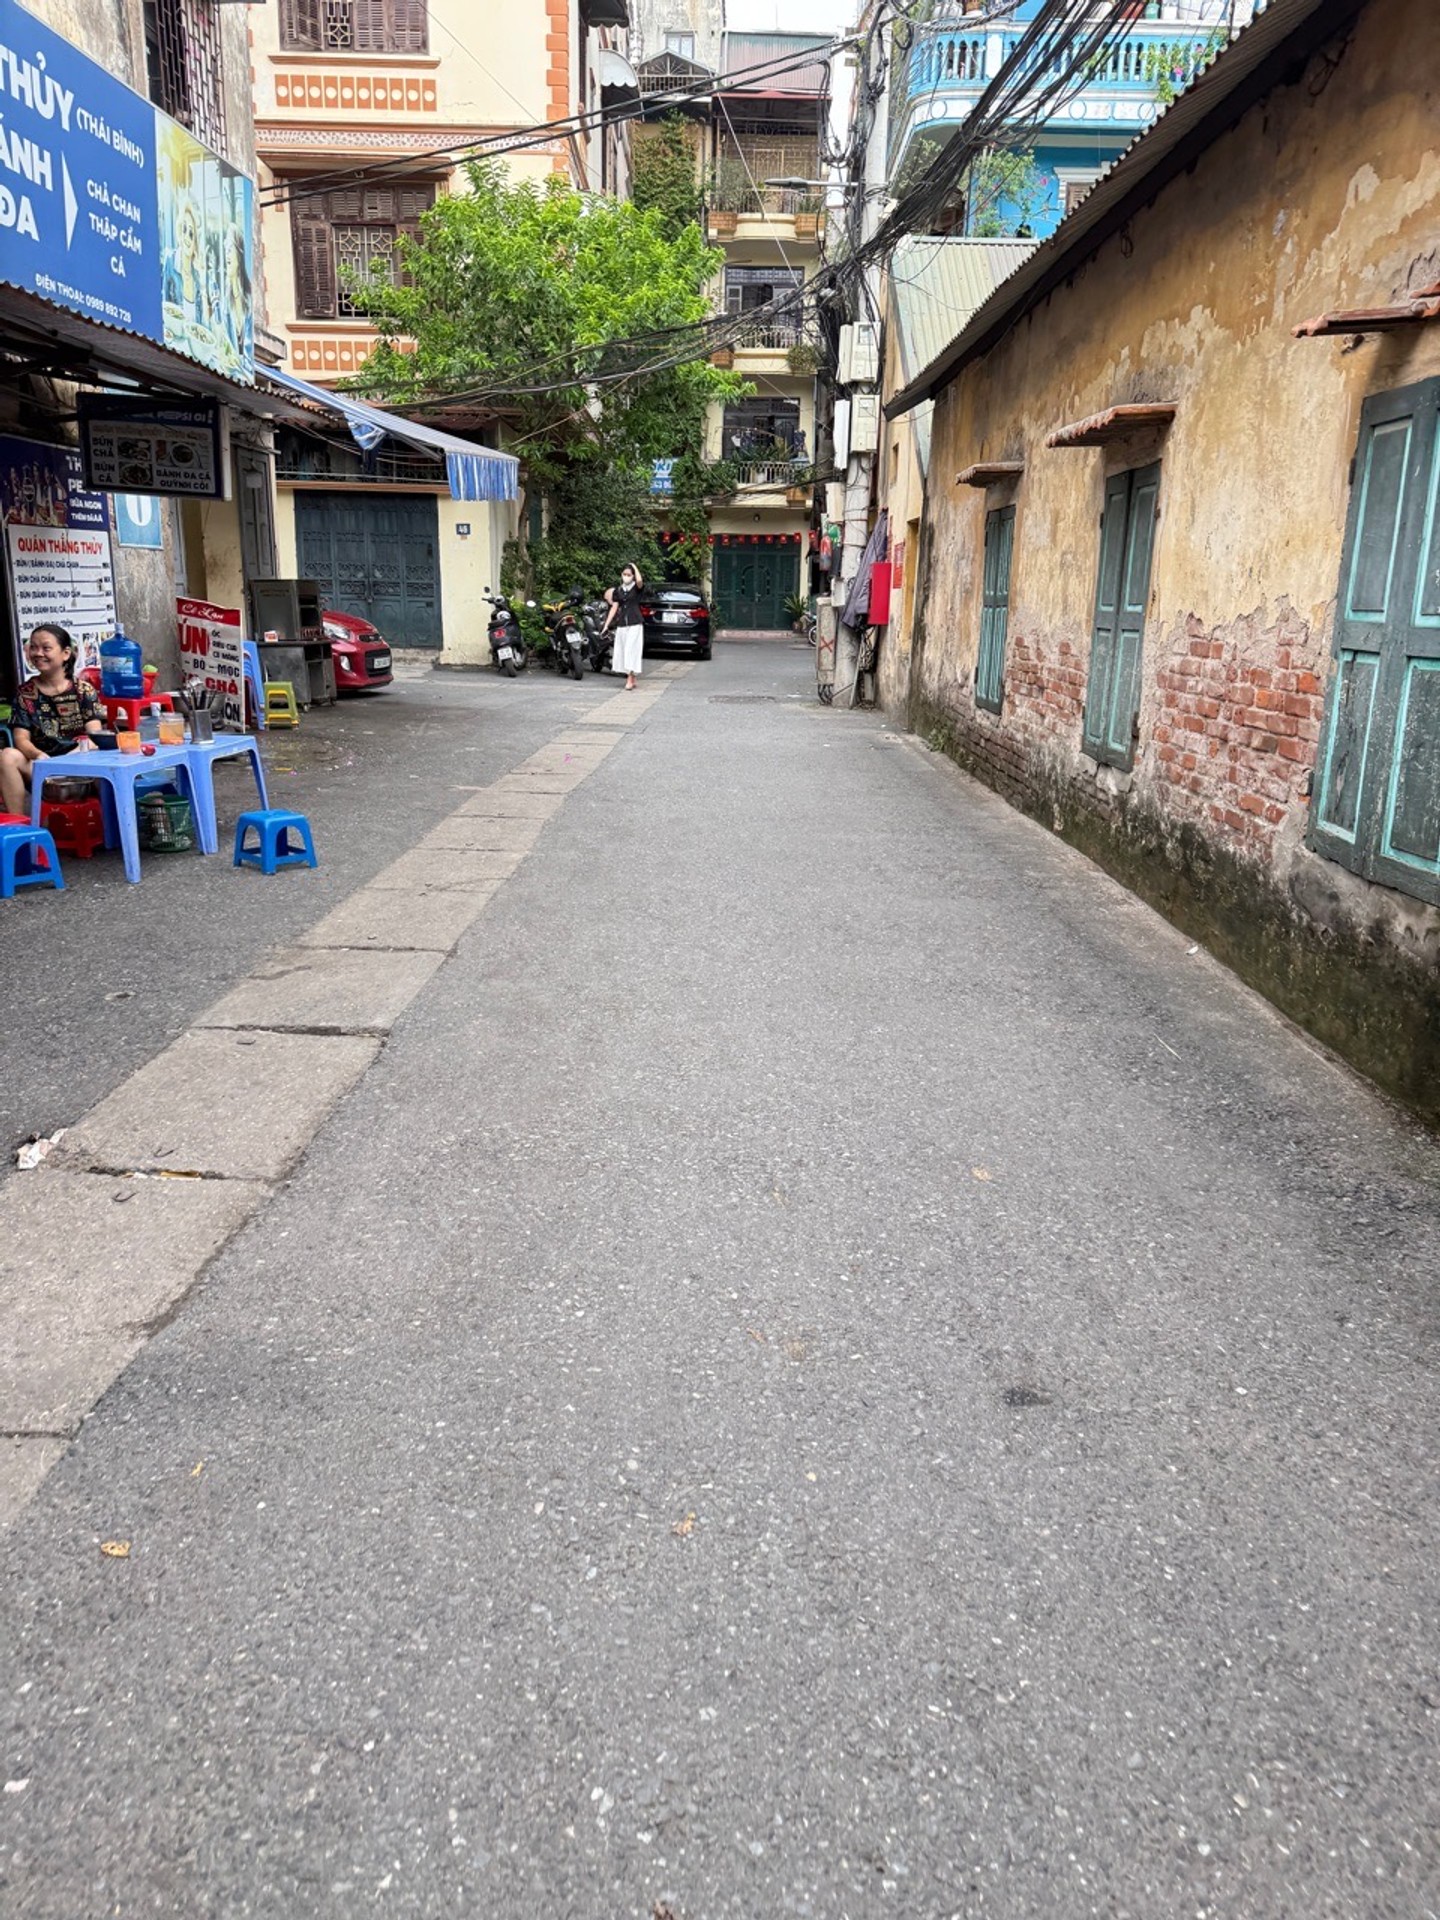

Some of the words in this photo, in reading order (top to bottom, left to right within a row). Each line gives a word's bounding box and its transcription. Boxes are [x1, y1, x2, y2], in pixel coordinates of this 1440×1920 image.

[0, 44, 75, 132] THỦY
[87, 179, 111, 206] CHẢ
[112, 195, 141, 224] CHAN
[89, 212, 118, 242] THẬP
[18, 534, 46, 553] QUÁN
